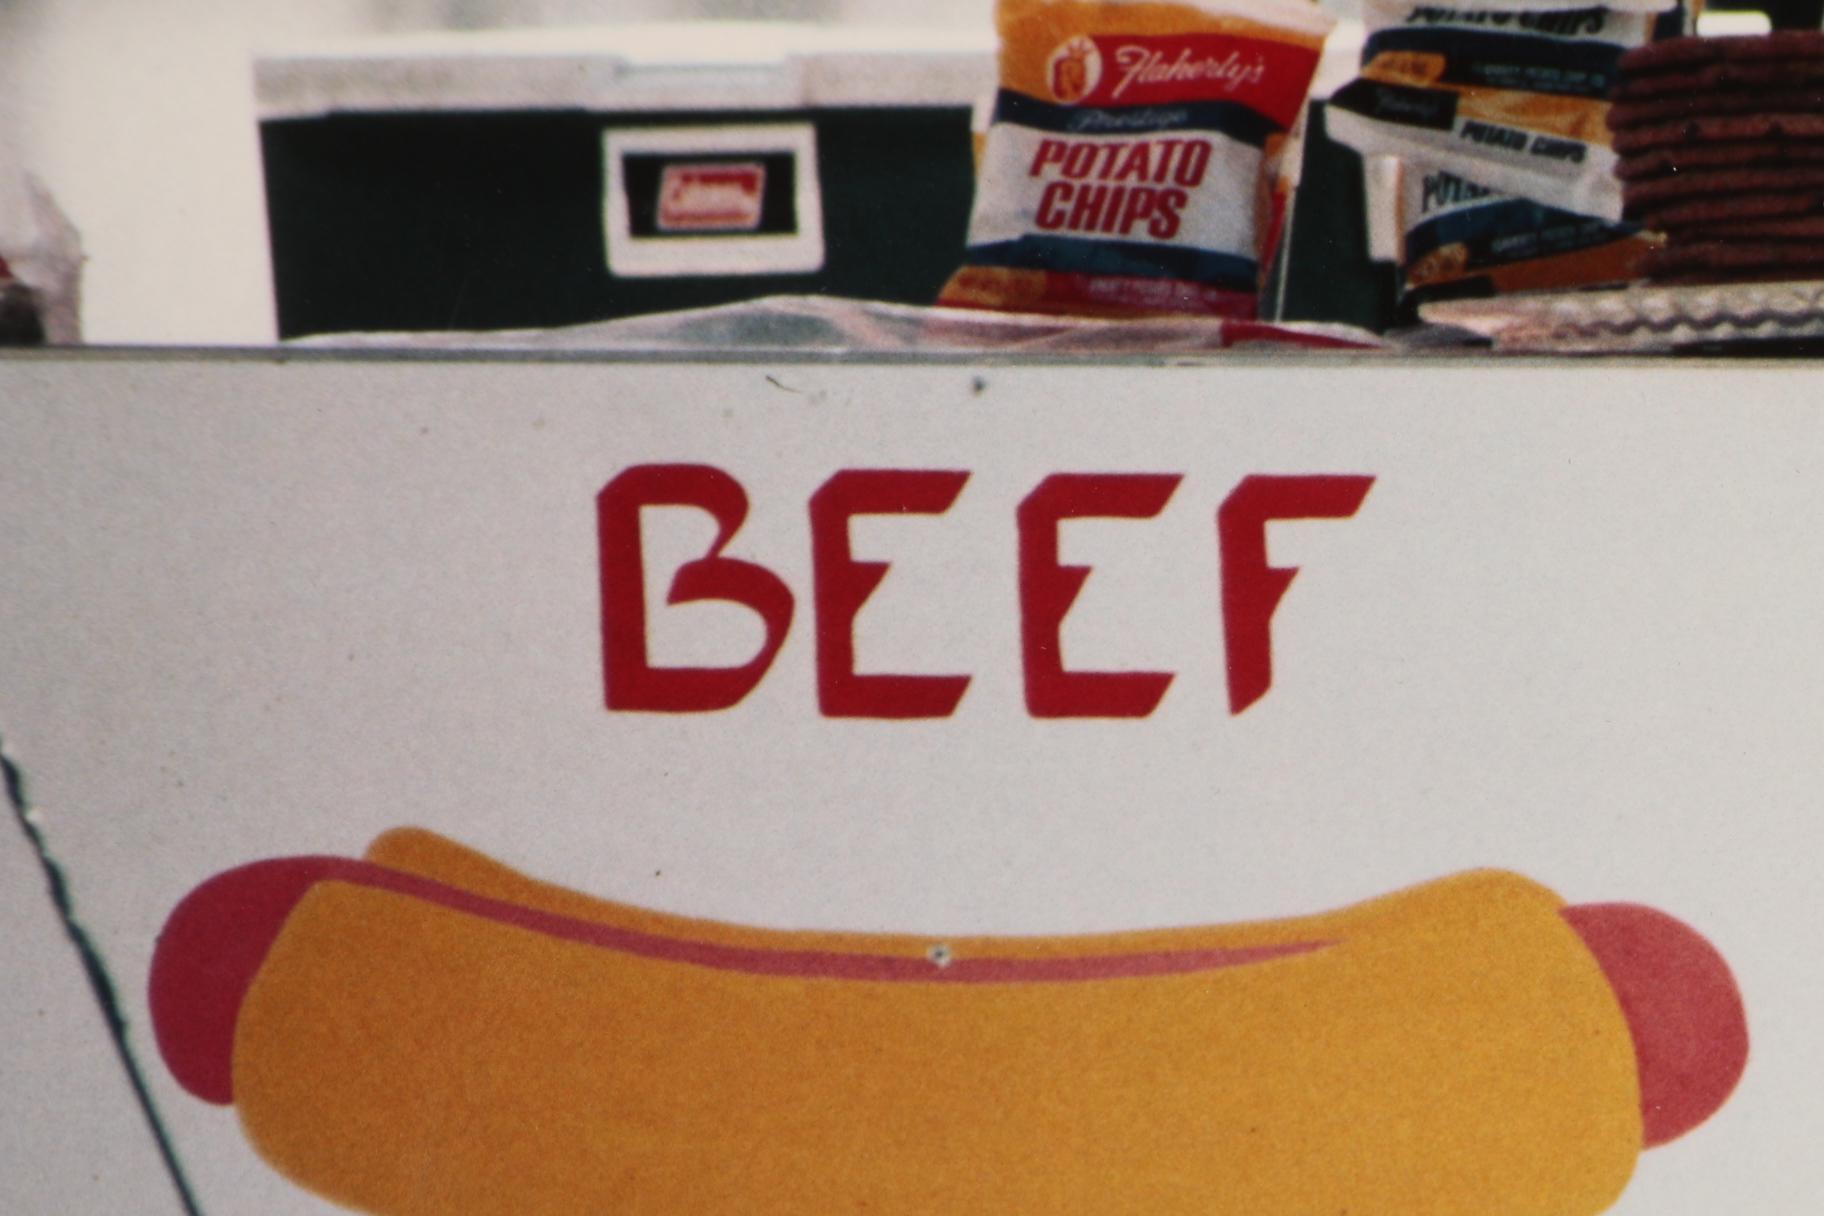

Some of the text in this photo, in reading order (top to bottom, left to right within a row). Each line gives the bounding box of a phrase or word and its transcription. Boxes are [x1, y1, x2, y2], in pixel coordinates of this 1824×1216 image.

[1029, 138, 1212, 187] POTATO
[1034, 181, 1188, 241] CHIPS
[596, 462, 1376, 721] BEEF
